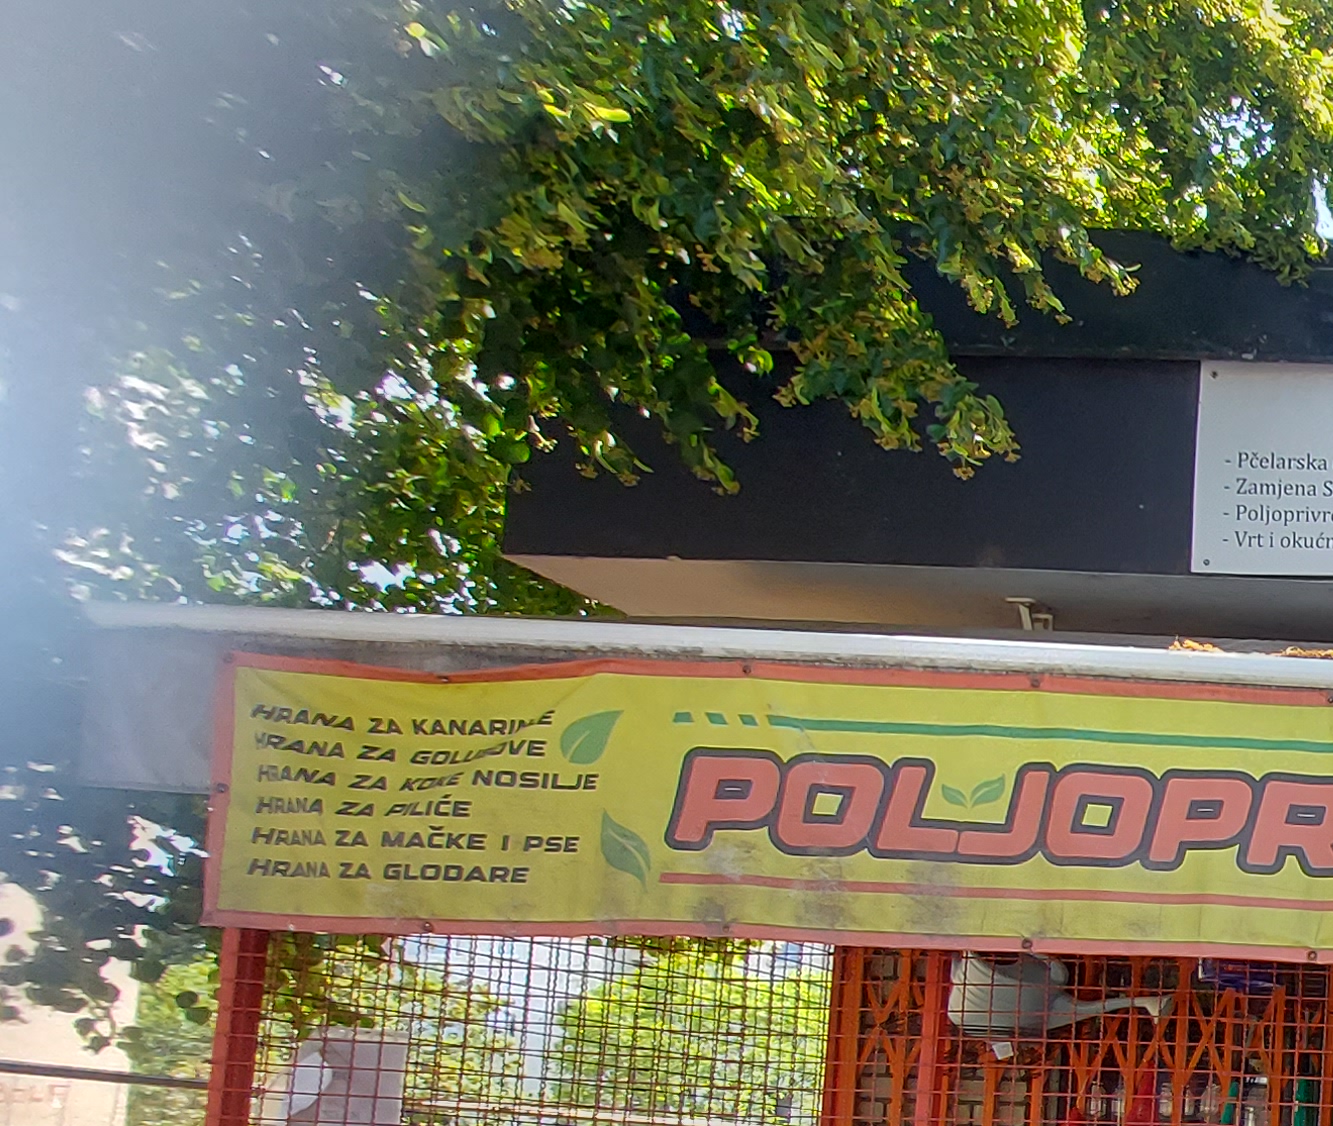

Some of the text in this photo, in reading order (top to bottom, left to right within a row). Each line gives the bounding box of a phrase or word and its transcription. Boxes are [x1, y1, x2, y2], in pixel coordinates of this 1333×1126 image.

[1237, 451, 1328, 472] Pčelarska
[1235, 478, 1317, 501] Zamjena
[1234, 530, 1264, 548] Vrt
[1269, 531, 1275, 548] i
[250, 703, 355, 731] HRANA
[367, 717, 403, 735] ZA
[254, 732, 344, 759] HRANA
[356, 744, 396, 762] ZA
[347, 774, 387, 791] ZA
[472, 769, 598, 791] NOSILJE
[255, 796, 323, 815] HRANA
[335, 801, 374, 817] ZA
[251, 824, 580, 853] HRANA ZA MAČKE I PSE
[247, 858, 530, 884] HRANA ZA GLODARE
